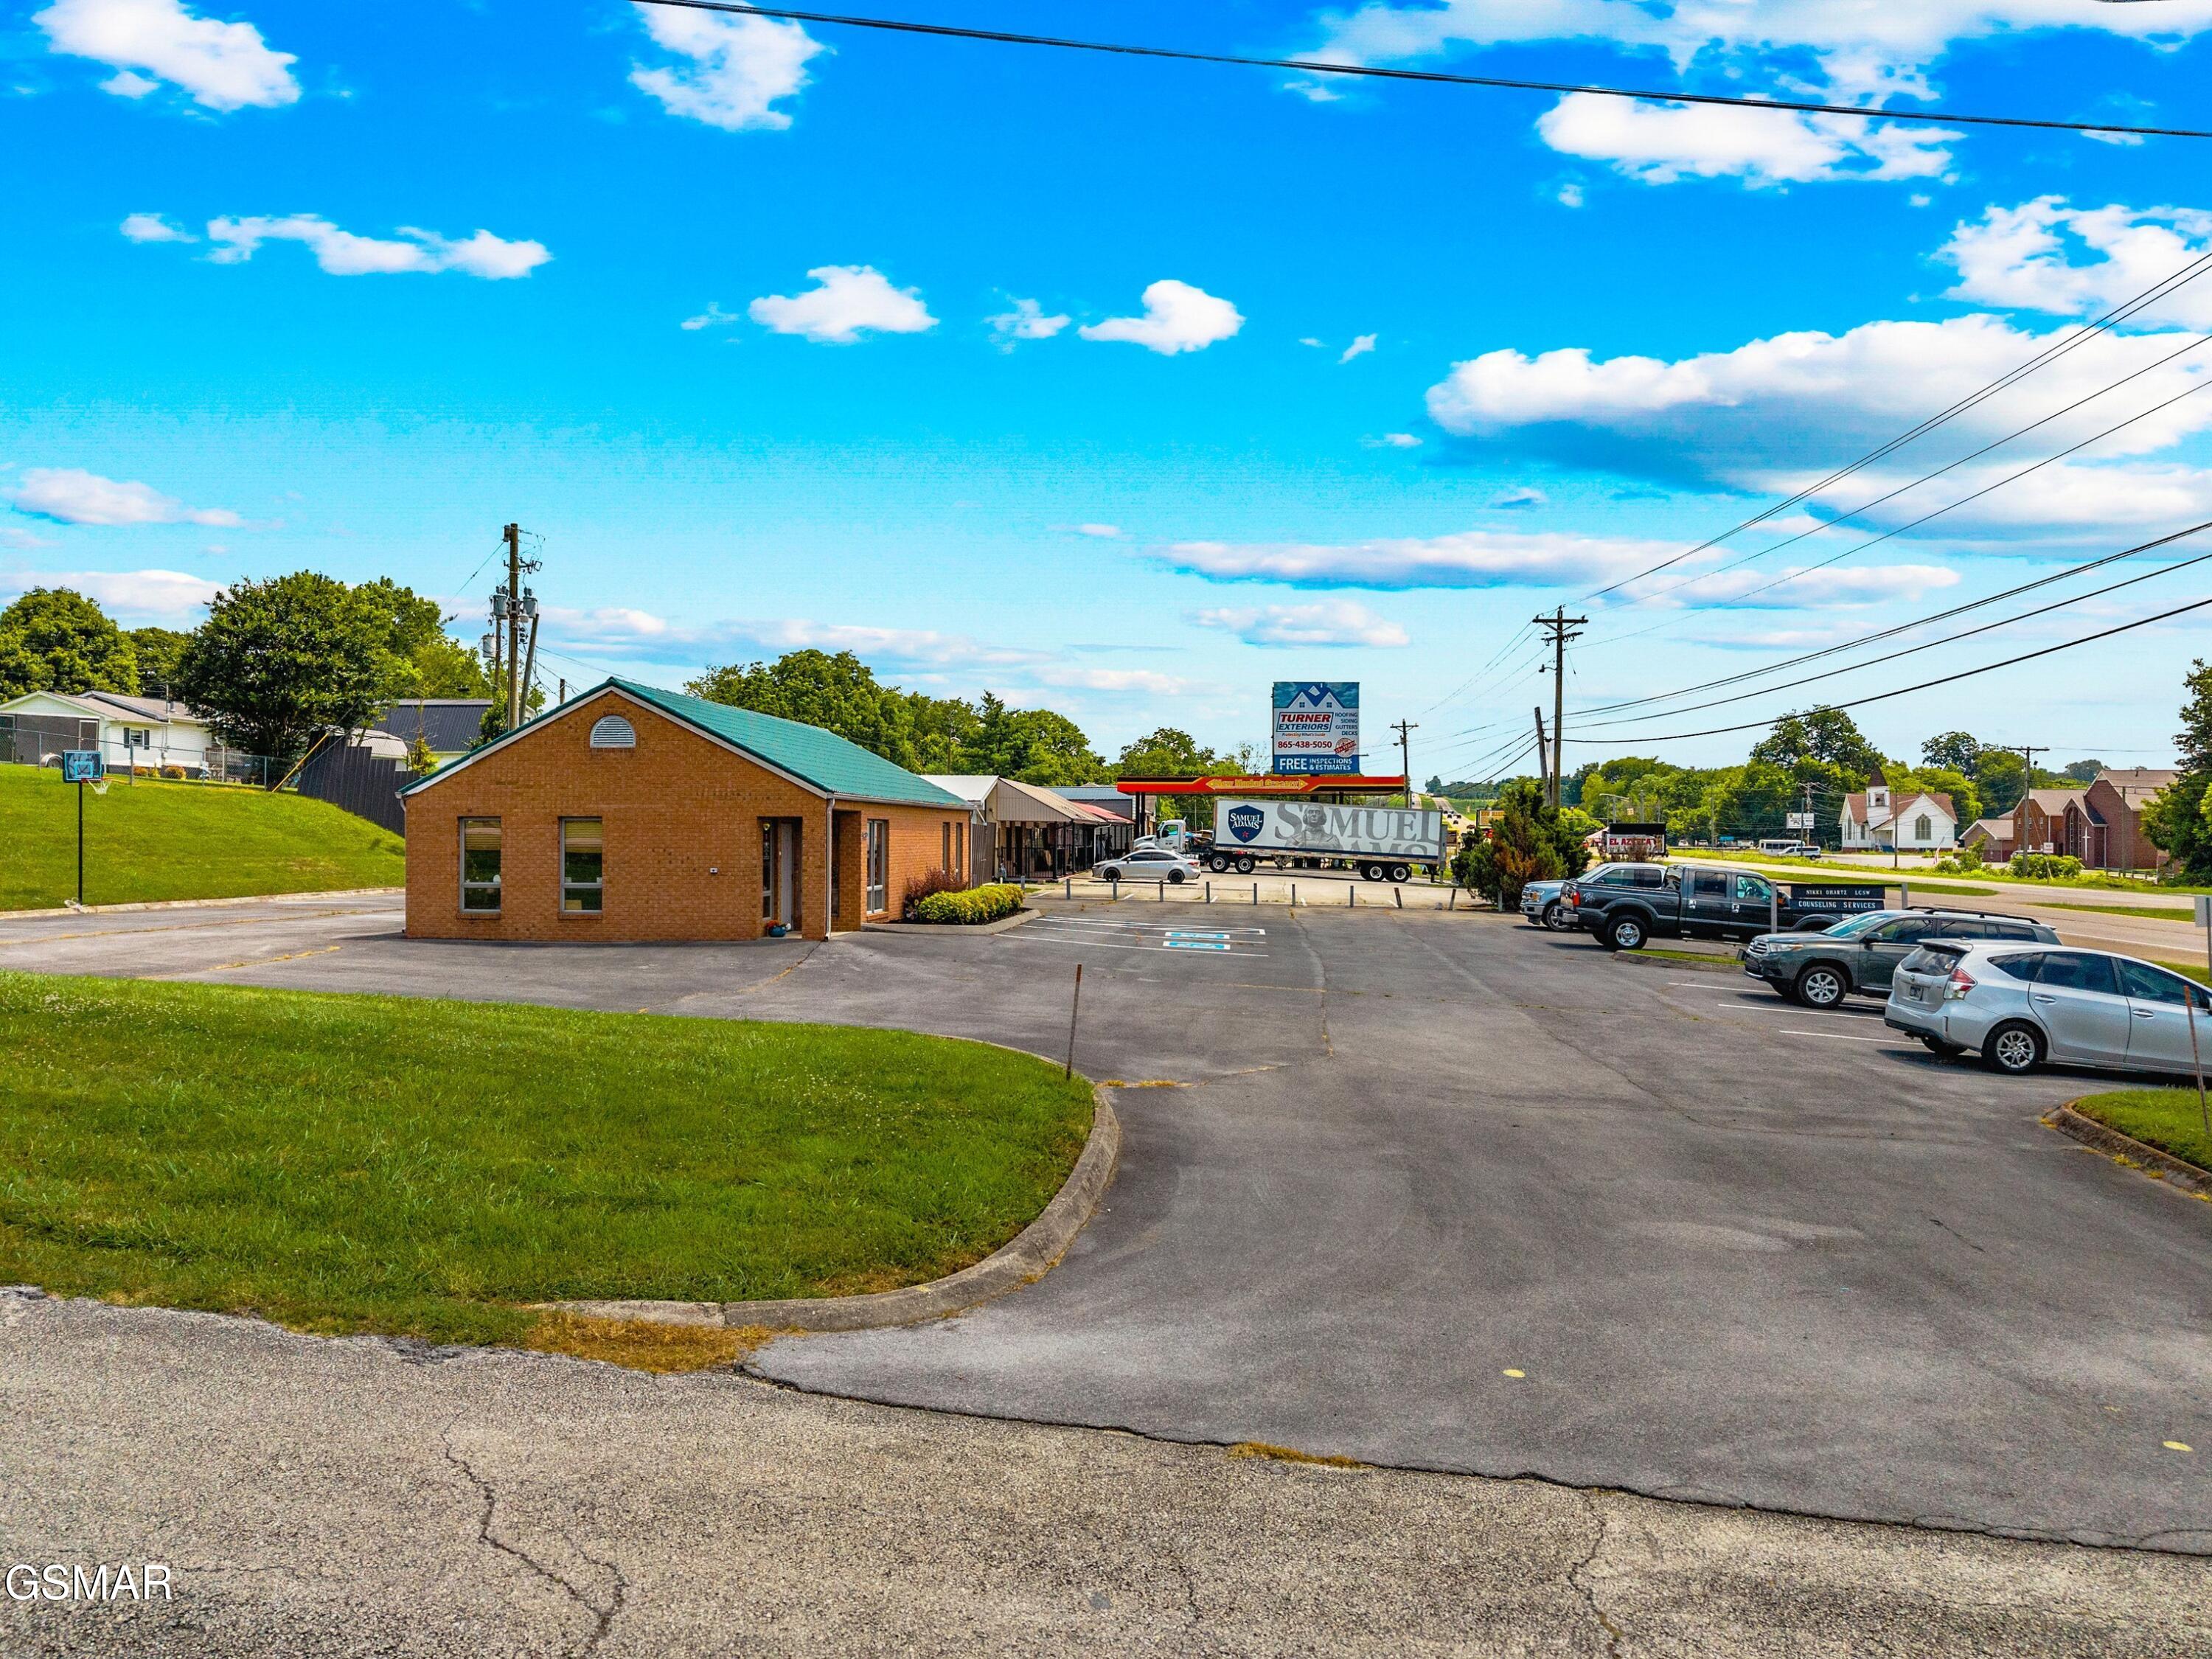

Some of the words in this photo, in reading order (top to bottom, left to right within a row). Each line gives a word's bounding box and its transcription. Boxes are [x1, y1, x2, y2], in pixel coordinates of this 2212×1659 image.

[1281, 714, 1331, 723] TURNER
[1277, 740, 1332, 748] 865-438-5050
[1279, 758, 1307, 771] FREE
[1230, 813, 1263, 823] SAMUEL
[1231, 820, 1259, 830] ADAMS
[1274, 802, 1440, 846] SMUEL
[1798, 900, 1837, 908] COUNSELING
[1843, 901, 1876, 909] SERVICES
